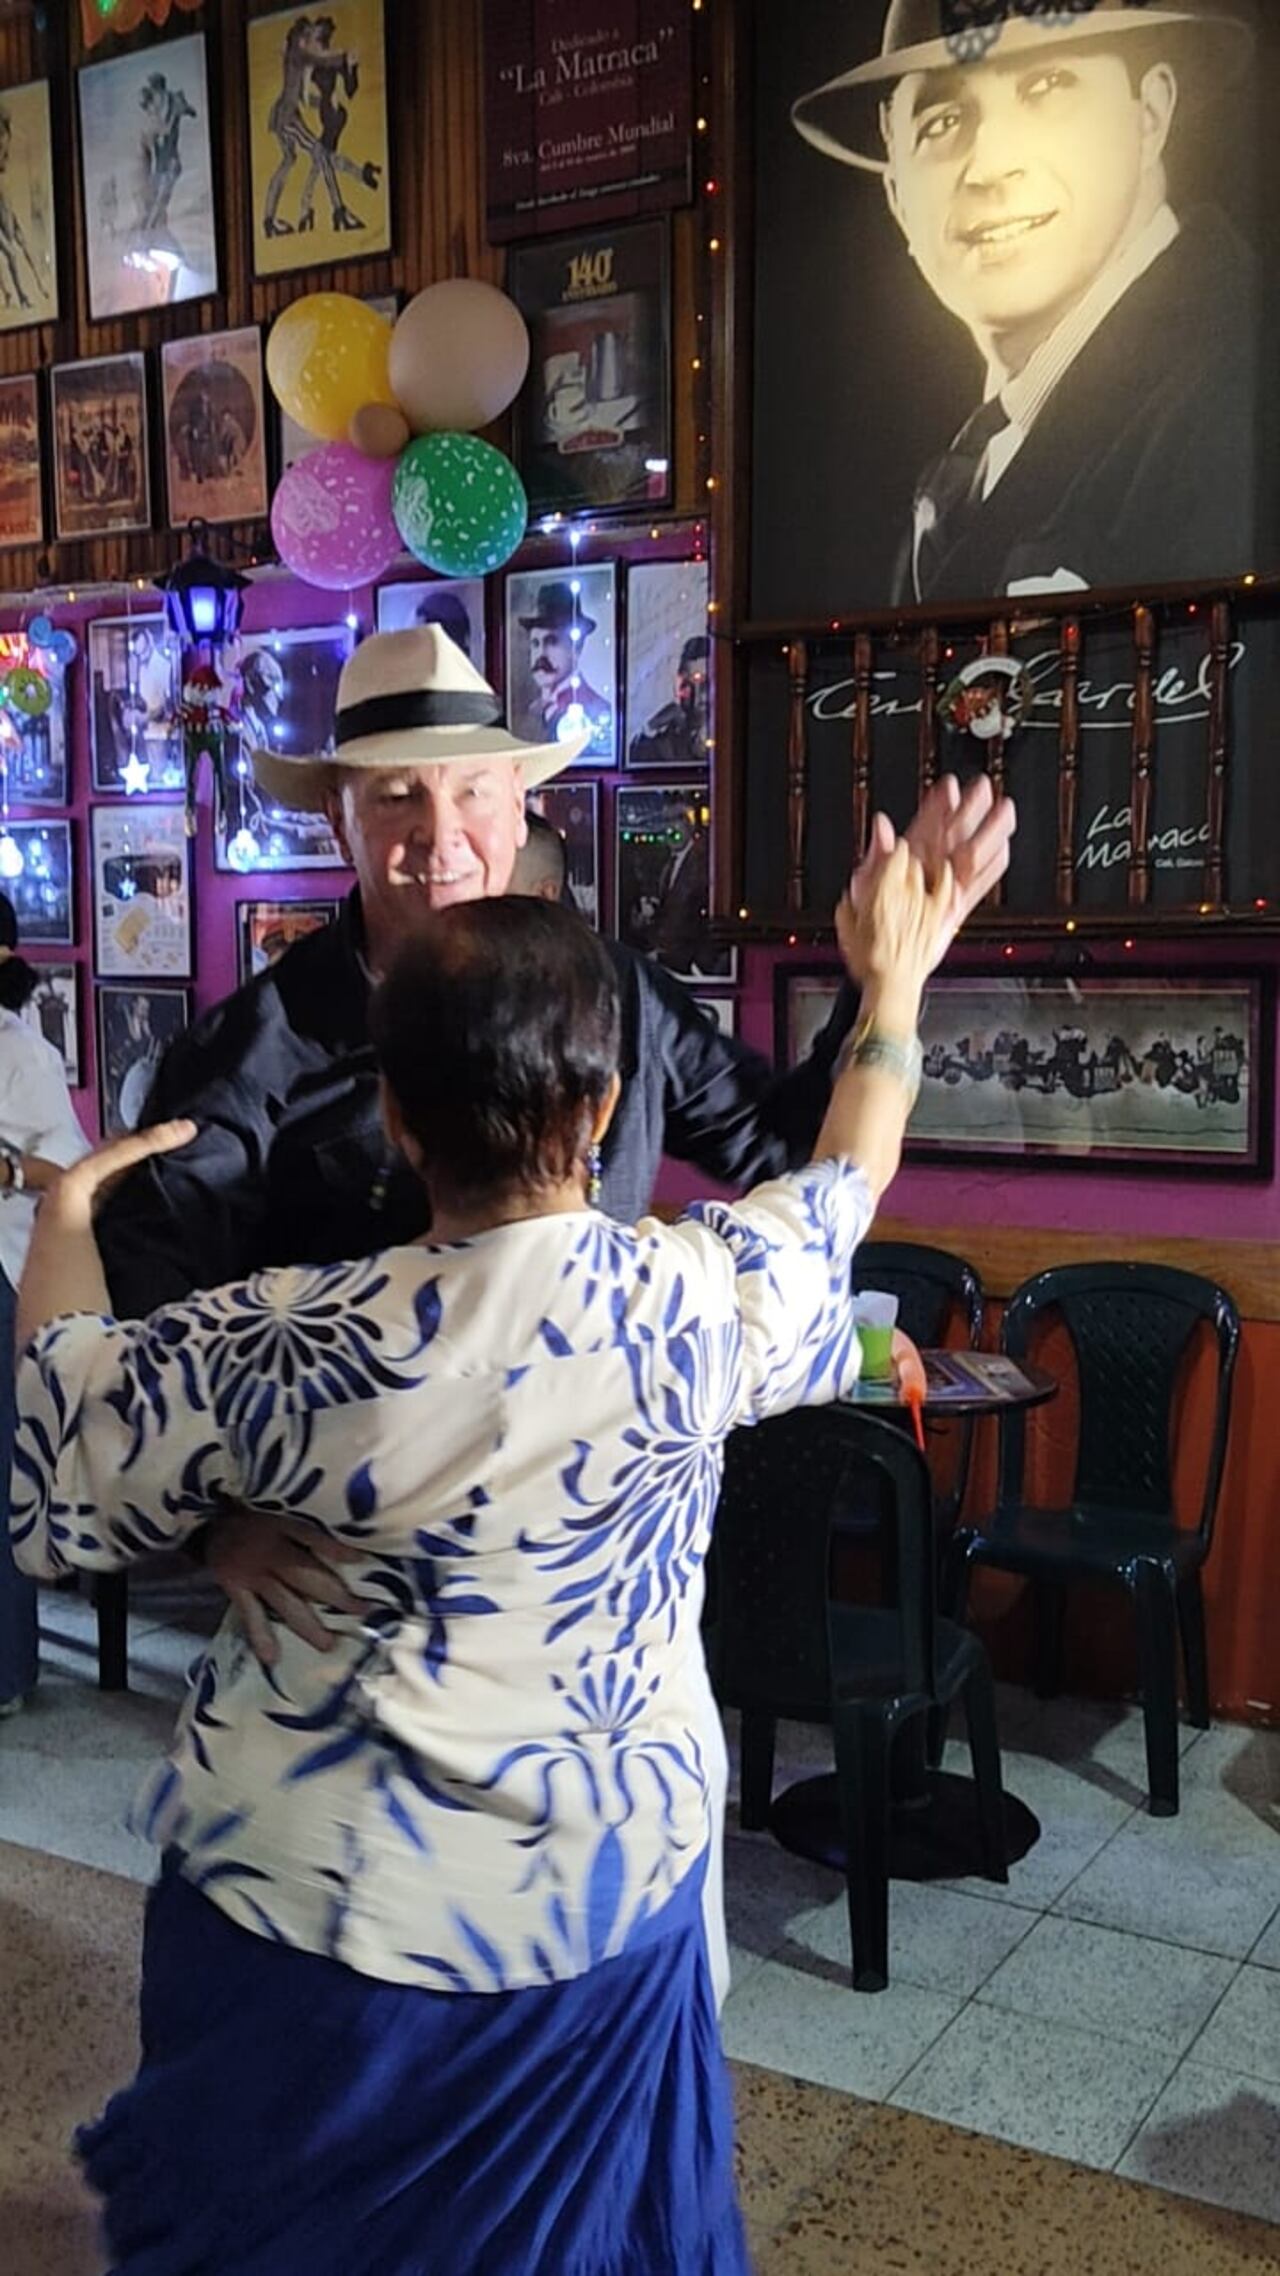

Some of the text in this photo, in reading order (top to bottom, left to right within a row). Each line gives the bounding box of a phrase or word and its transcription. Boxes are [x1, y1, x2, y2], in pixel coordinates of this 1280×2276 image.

[538, 132, 603, 159] Cumbre
[608, 113, 675, 145] Mundial
[1086, 805, 1132, 840] La
